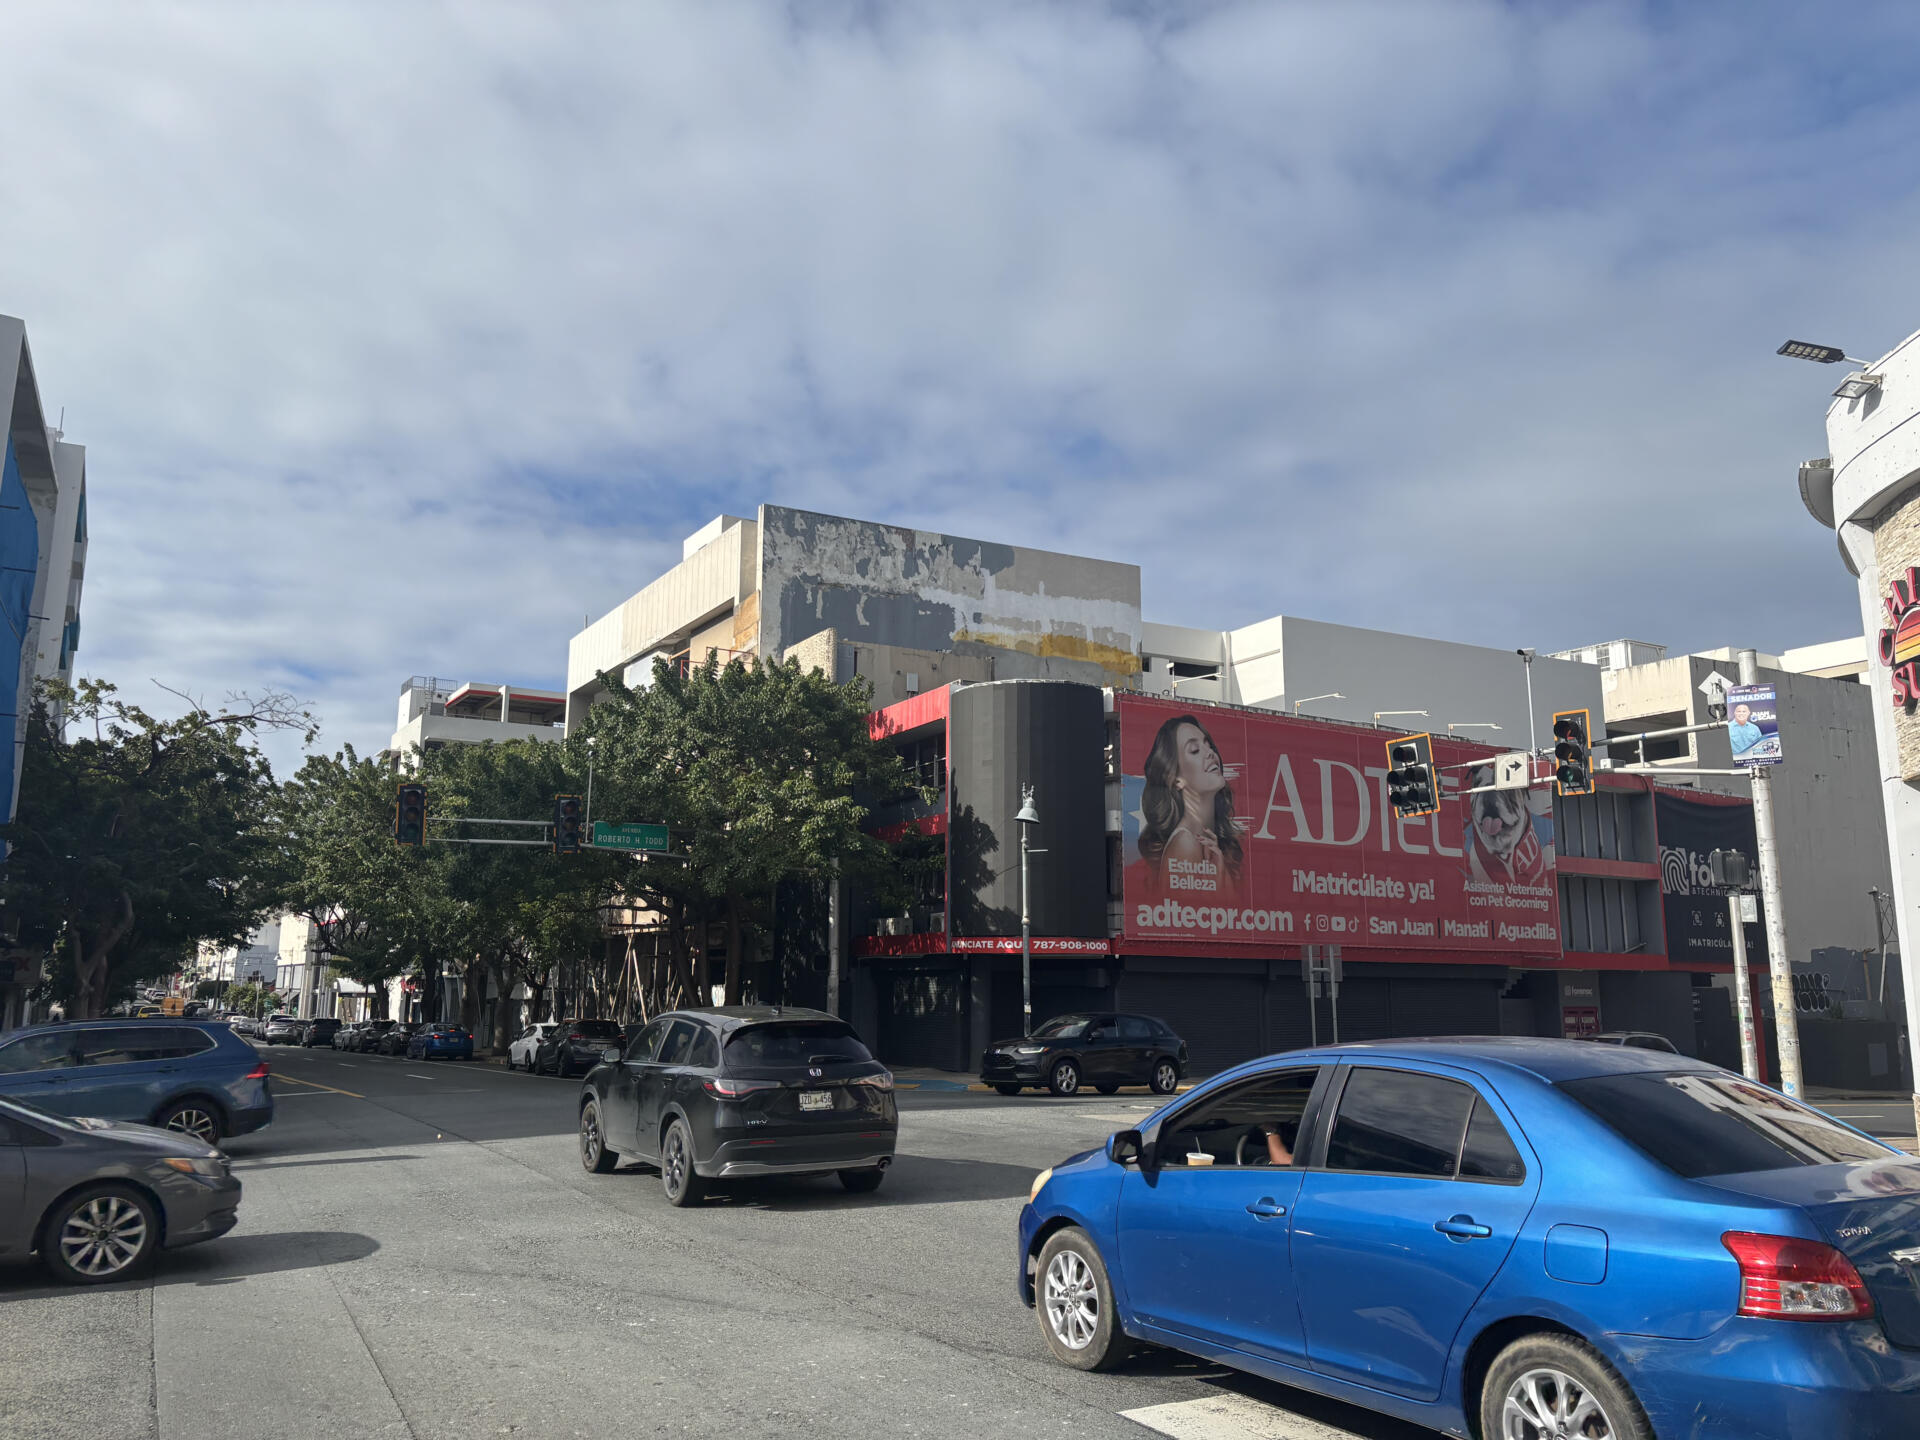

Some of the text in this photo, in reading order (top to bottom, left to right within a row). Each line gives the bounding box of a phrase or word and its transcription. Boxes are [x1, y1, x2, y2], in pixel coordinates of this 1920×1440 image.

[1730, 693, 1772, 702] SENADOR
[597, 834, 631, 844] ROBERTO
[645, 837, 664, 845] TODD
[1168, 858, 1217, 875] Estudia
[1169, 875, 1217, 891] Belleza
[1292, 869, 1436, 904] ¡Matricúlate ya!
[1463, 880, 1553, 897] Asistente Veterinario
[1469, 896, 1549, 911] con Pet Grooming
[1136, 898, 1294, 935] adtecpr.com
[1369, 916, 1557, 942] San Juan Manatí Aguadilla
[996, 939, 1023, 950] AQU
[1033, 940, 1108, 951] 787-908-1000
